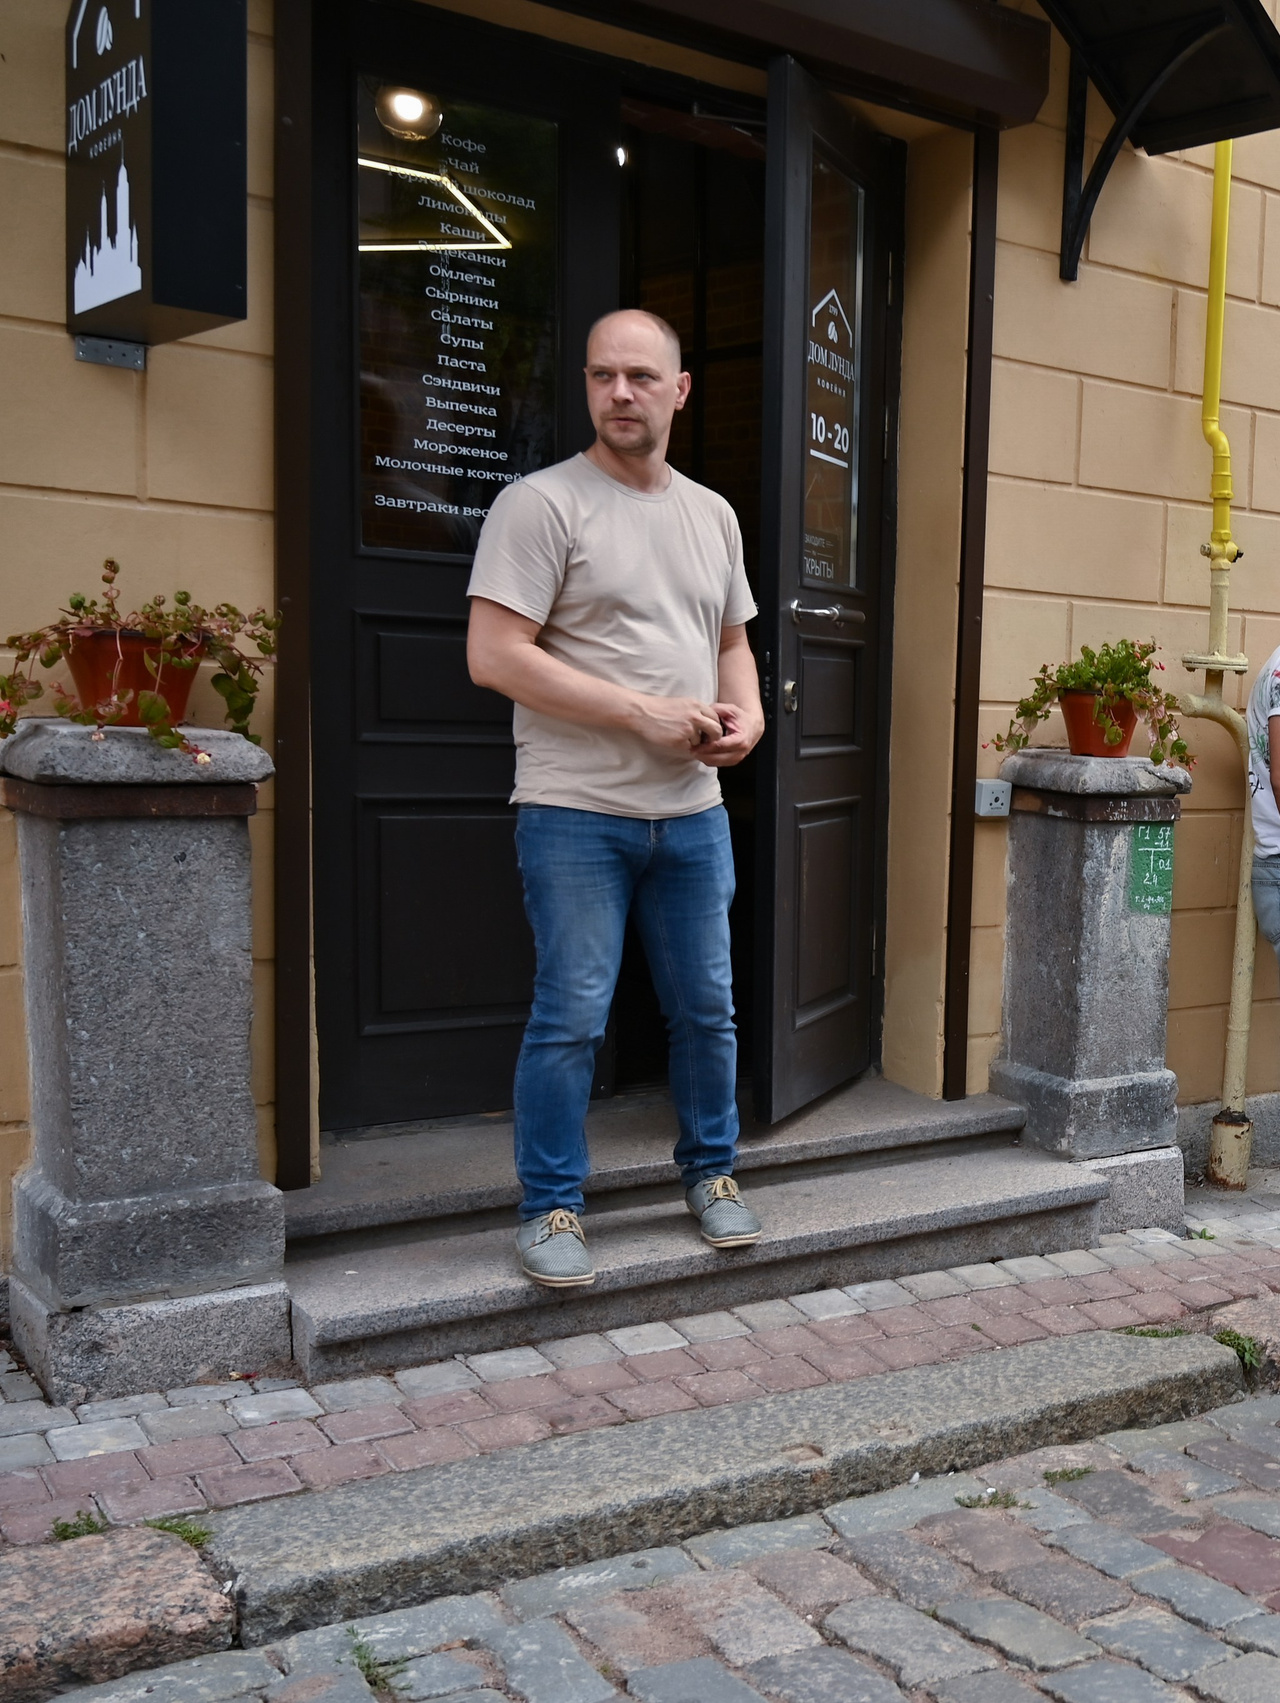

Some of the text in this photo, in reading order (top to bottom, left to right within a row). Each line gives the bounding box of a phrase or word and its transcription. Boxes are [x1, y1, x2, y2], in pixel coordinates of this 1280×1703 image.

[68, 55, 147, 157] ДОМ ЛУНДА
[441, 132, 487, 154] Кофе
[447, 156, 480, 175] Чай
[463, 184, 536, 210] шоколад
[440, 222, 487, 242] Каши
[429, 264, 496, 287] Омлеты
[425, 286, 499, 309] Сырники
[431, 309, 494, 330] Салаты
[440, 333, 484, 350] Супы
[437, 354, 487, 372] Паста
[808, 340, 855, 382] ДОМ ЛУНДА
[422, 374, 501, 396] Сэндвичи
[817, 377, 846, 398] КОФЕЙНЯ
[425, 396, 497, 417] Выпечка
[426, 418, 497, 438] Десерты
[413, 438, 509, 461] Мороженое
[375, 455, 464, 477] Молочные
[374, 494, 459, 515] Завтраки
